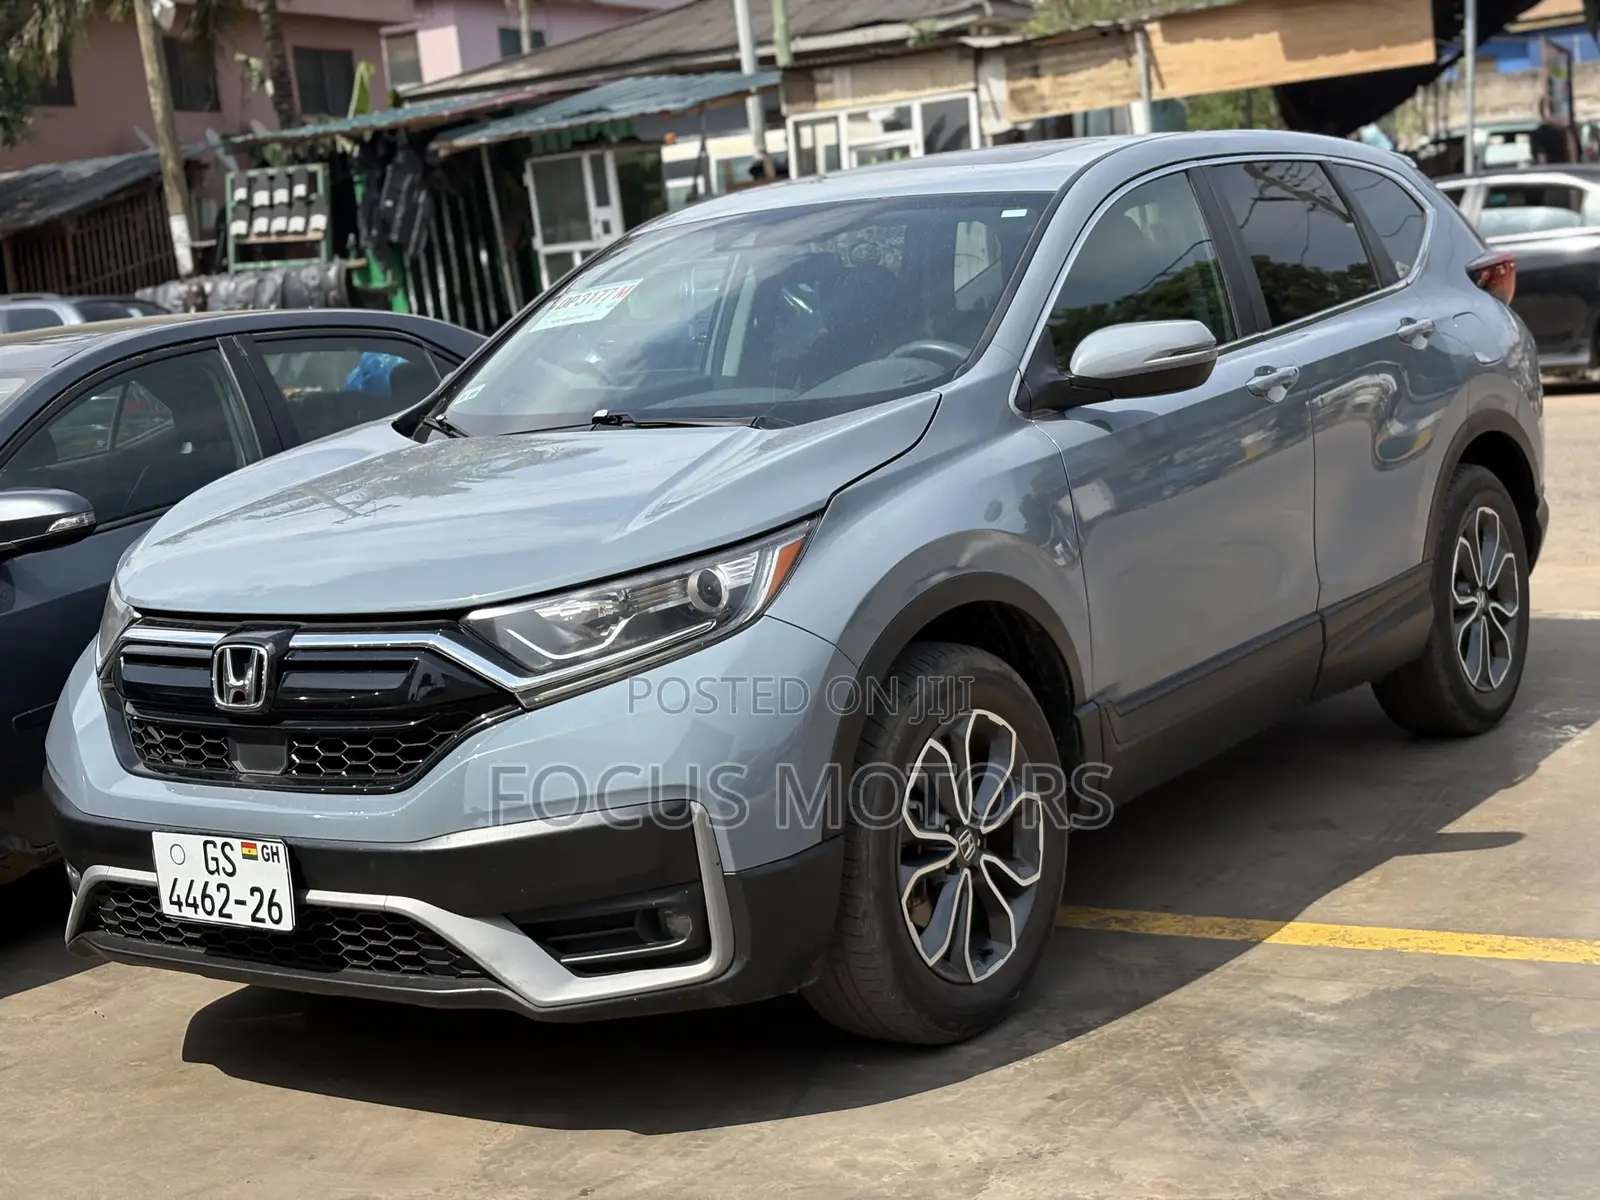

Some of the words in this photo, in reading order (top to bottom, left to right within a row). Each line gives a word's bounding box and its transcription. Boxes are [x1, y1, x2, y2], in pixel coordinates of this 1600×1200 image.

[202, 839, 237, 877] GS
[261, 844, 281, 863] GH
[168, 877, 284, 925] 4462-26
